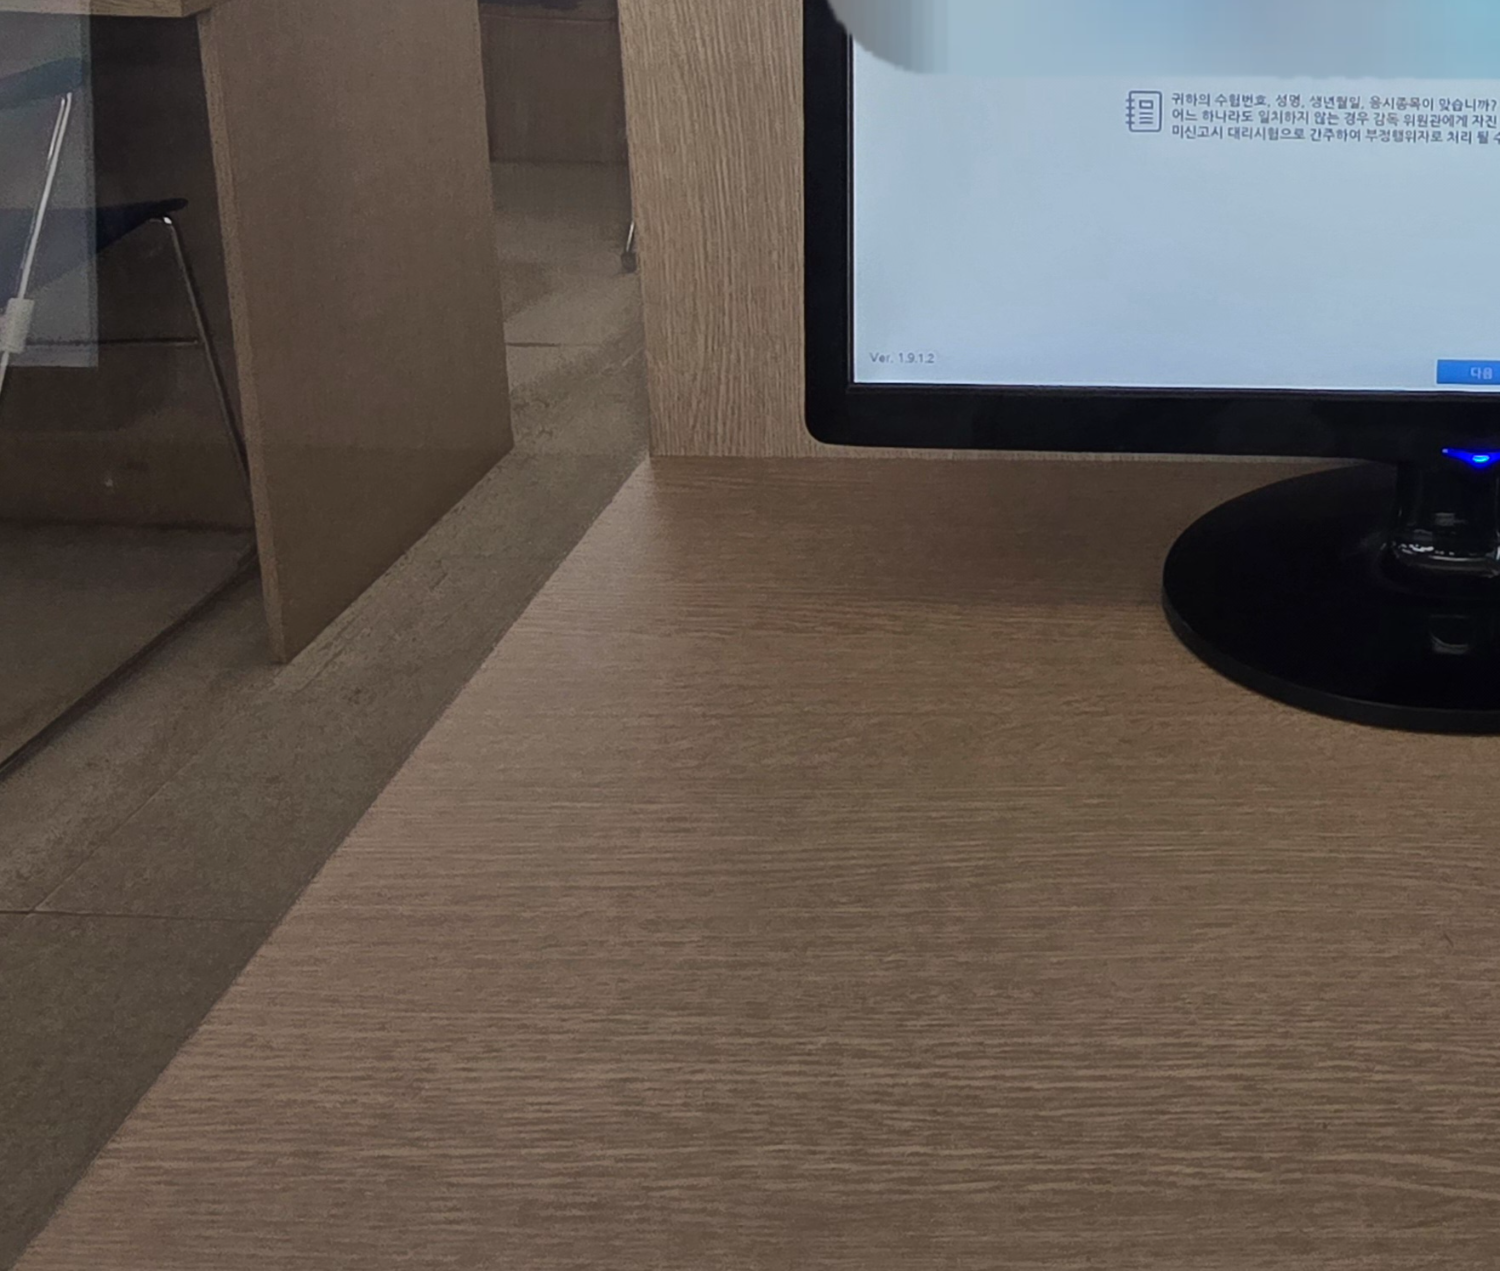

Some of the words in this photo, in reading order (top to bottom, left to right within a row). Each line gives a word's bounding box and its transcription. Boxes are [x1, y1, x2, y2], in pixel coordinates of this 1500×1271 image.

[1171, 92, 1211, 106] 귀하의
[1214, 92, 1271, 108] 수험번호,
[1275, 94, 1305, 109] 성명,
[1309, 95, 1365, 110] 생년월일,
[1369, 96, 1434, 111] 응시종목이
[1438, 97, 1498, 112] 맞습니까?
[1172, 108, 1198, 122] 어느
[1202, 109, 1254, 124] 하나라도
[1258, 110, 1309, 125] 일치하지
[1313, 111, 1340, 126] 않는
[1343, 112, 1369, 127] 경우
[1373, 112, 1399, 127] 감독
[1472, 115, 1497, 129] 자진
[1172, 125, 1223, 139] 미신고시
[1227, 126, 1305, 141] 대리시험으로
[1310, 127, 1361, 142] 간주하여
[1365, 129, 1443, 144] 부정행위자로
[1447, 131, 1472, 145] 처리
[869, 352, 894, 364] Ver.
